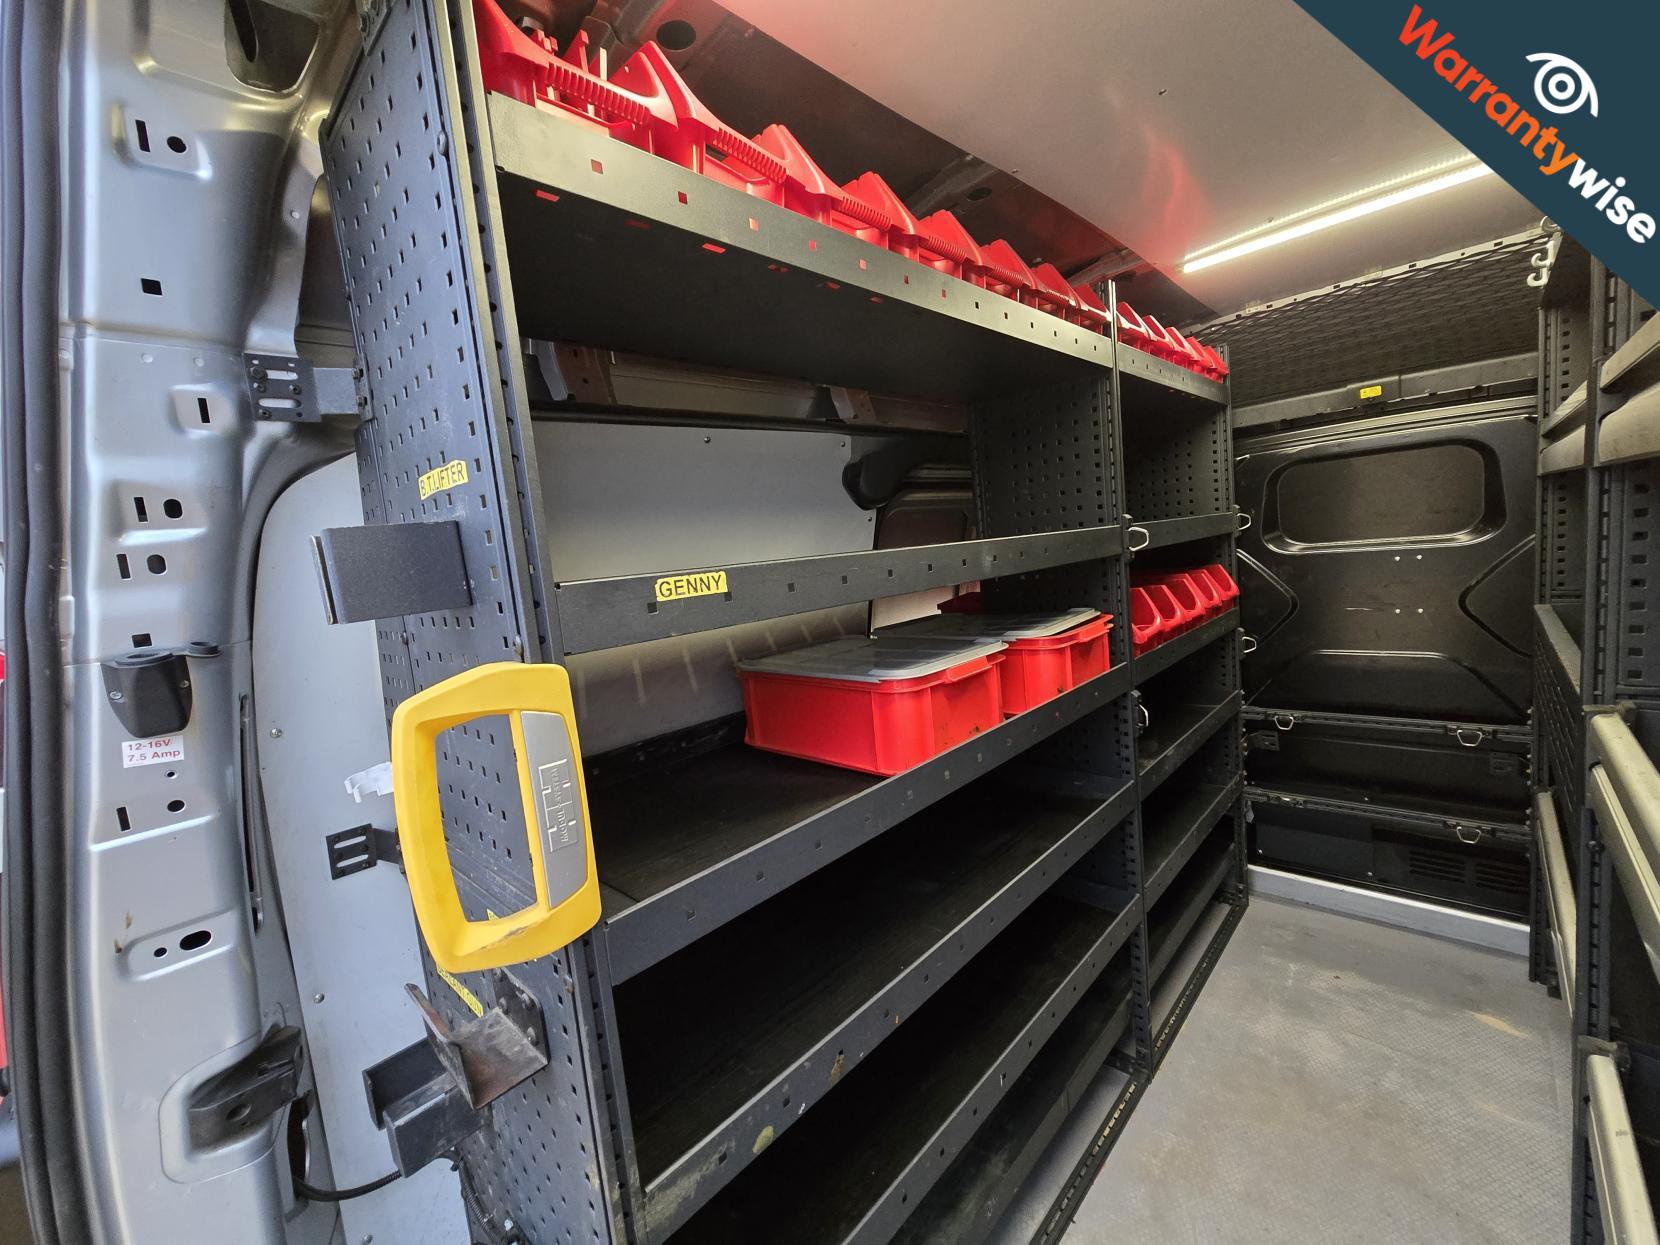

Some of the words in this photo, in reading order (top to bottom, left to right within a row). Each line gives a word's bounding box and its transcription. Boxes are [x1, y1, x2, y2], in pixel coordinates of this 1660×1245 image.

[658, 574, 722, 598] GENNY
[128, 739, 171, 751] 12-16V
[128, 754, 147, 762] 7.5
[152, 750, 181, 760] Amp
